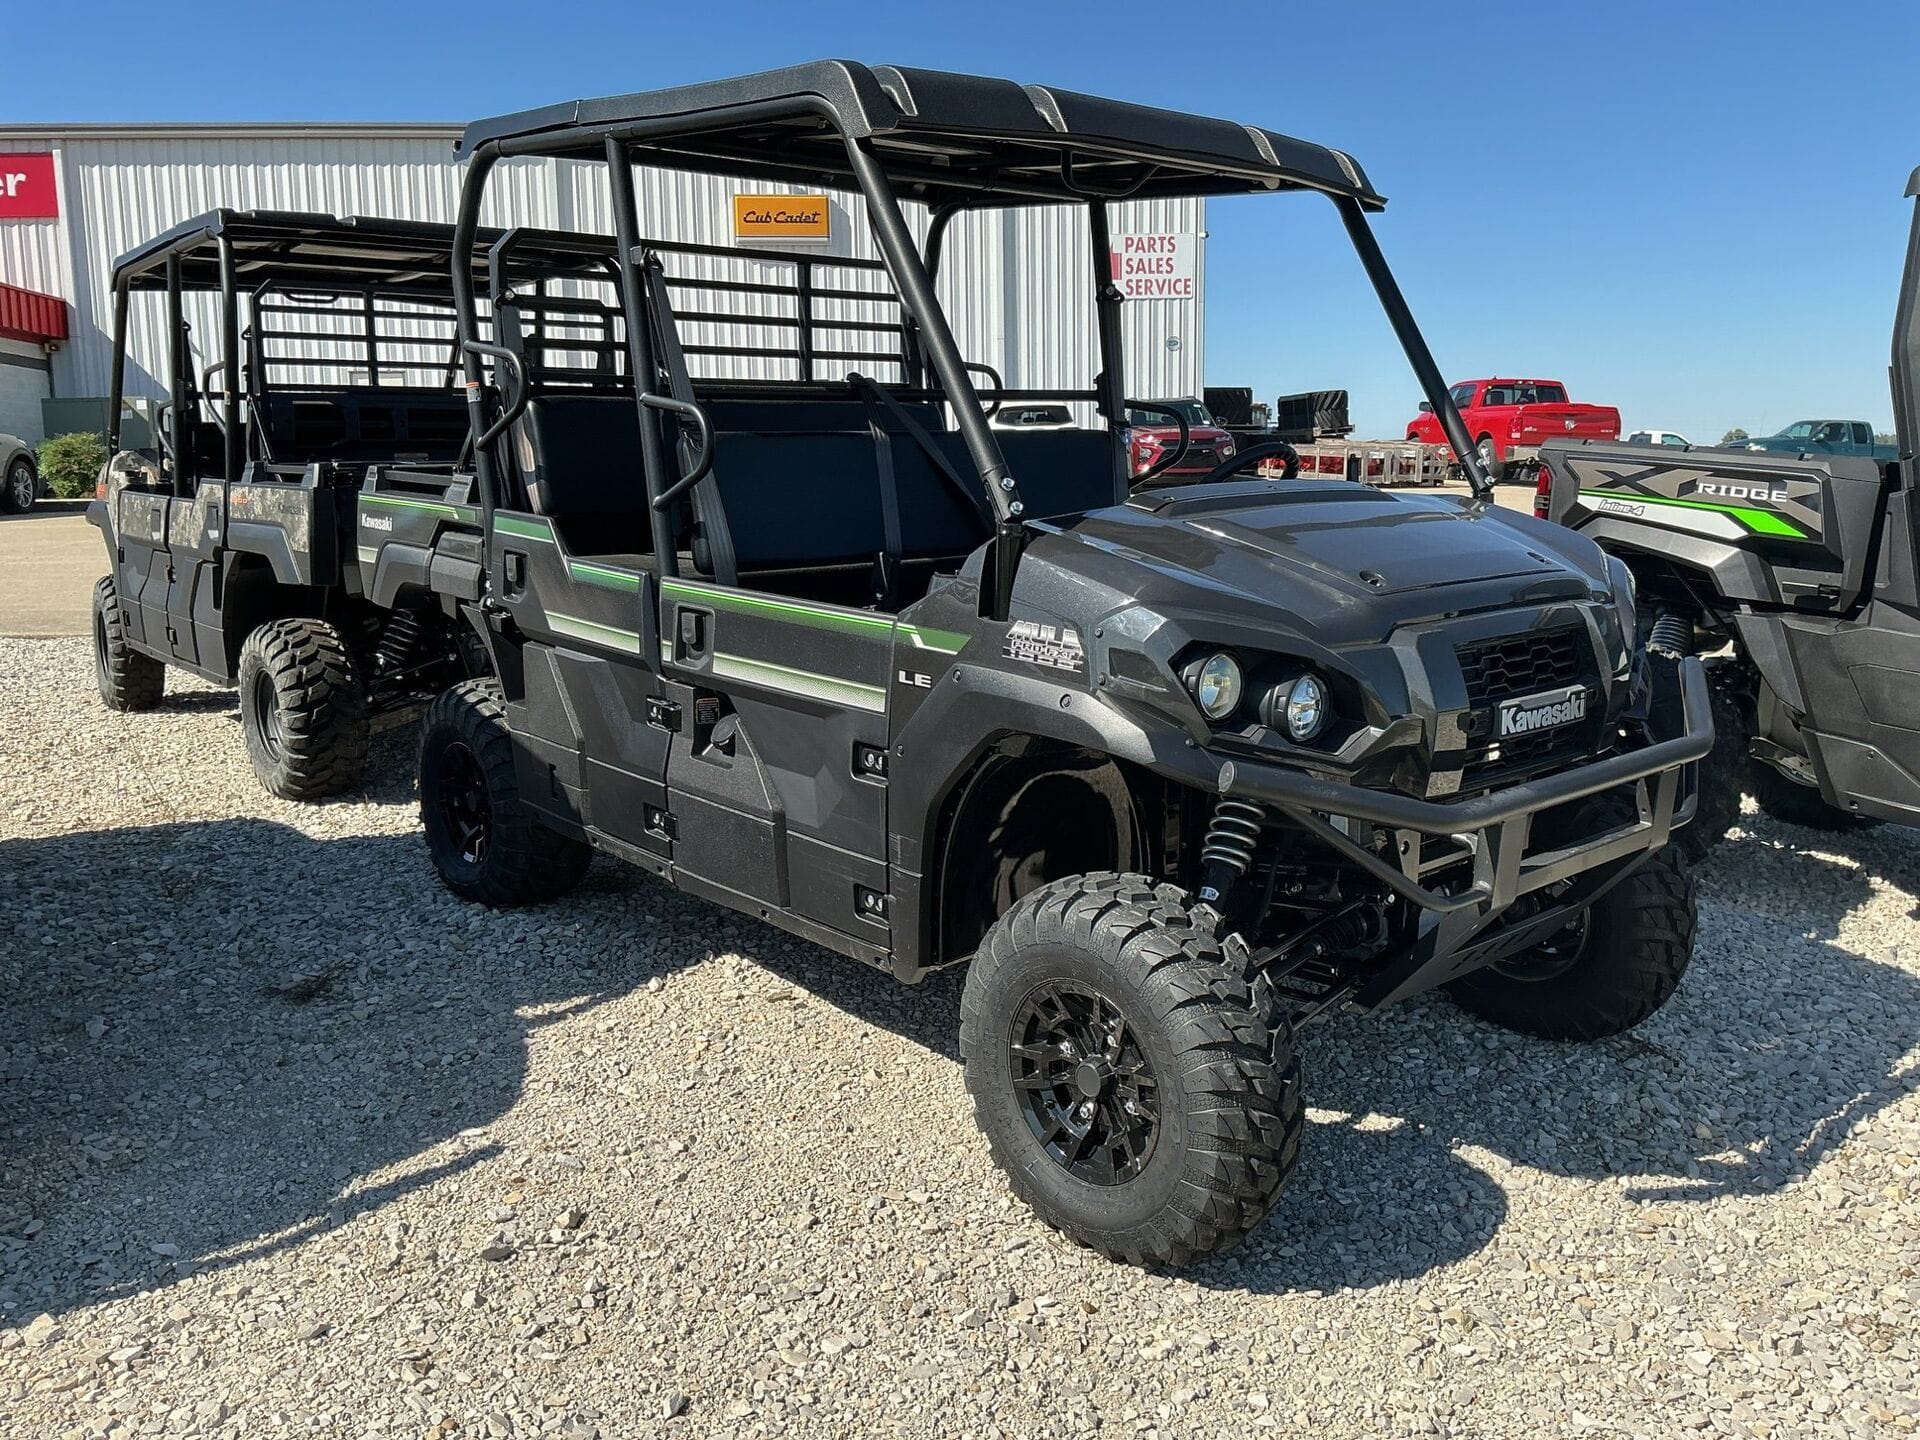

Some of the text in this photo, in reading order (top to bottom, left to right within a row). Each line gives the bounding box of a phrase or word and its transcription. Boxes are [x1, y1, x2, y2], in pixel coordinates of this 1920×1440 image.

[0, 173, 27, 197] r
[743, 210, 821, 224] Cub Cadet
[1125, 236, 1176, 253] PARTS
[1125, 257, 1174, 275] SALES
[1125, 278, 1191, 296] SERVICE
[1697, 482, 1788, 503] RIDGE
[361, 512, 393, 532] Kawasaki
[898, 670, 932, 688] LE
[1501, 692, 1585, 735] Kawasaki
